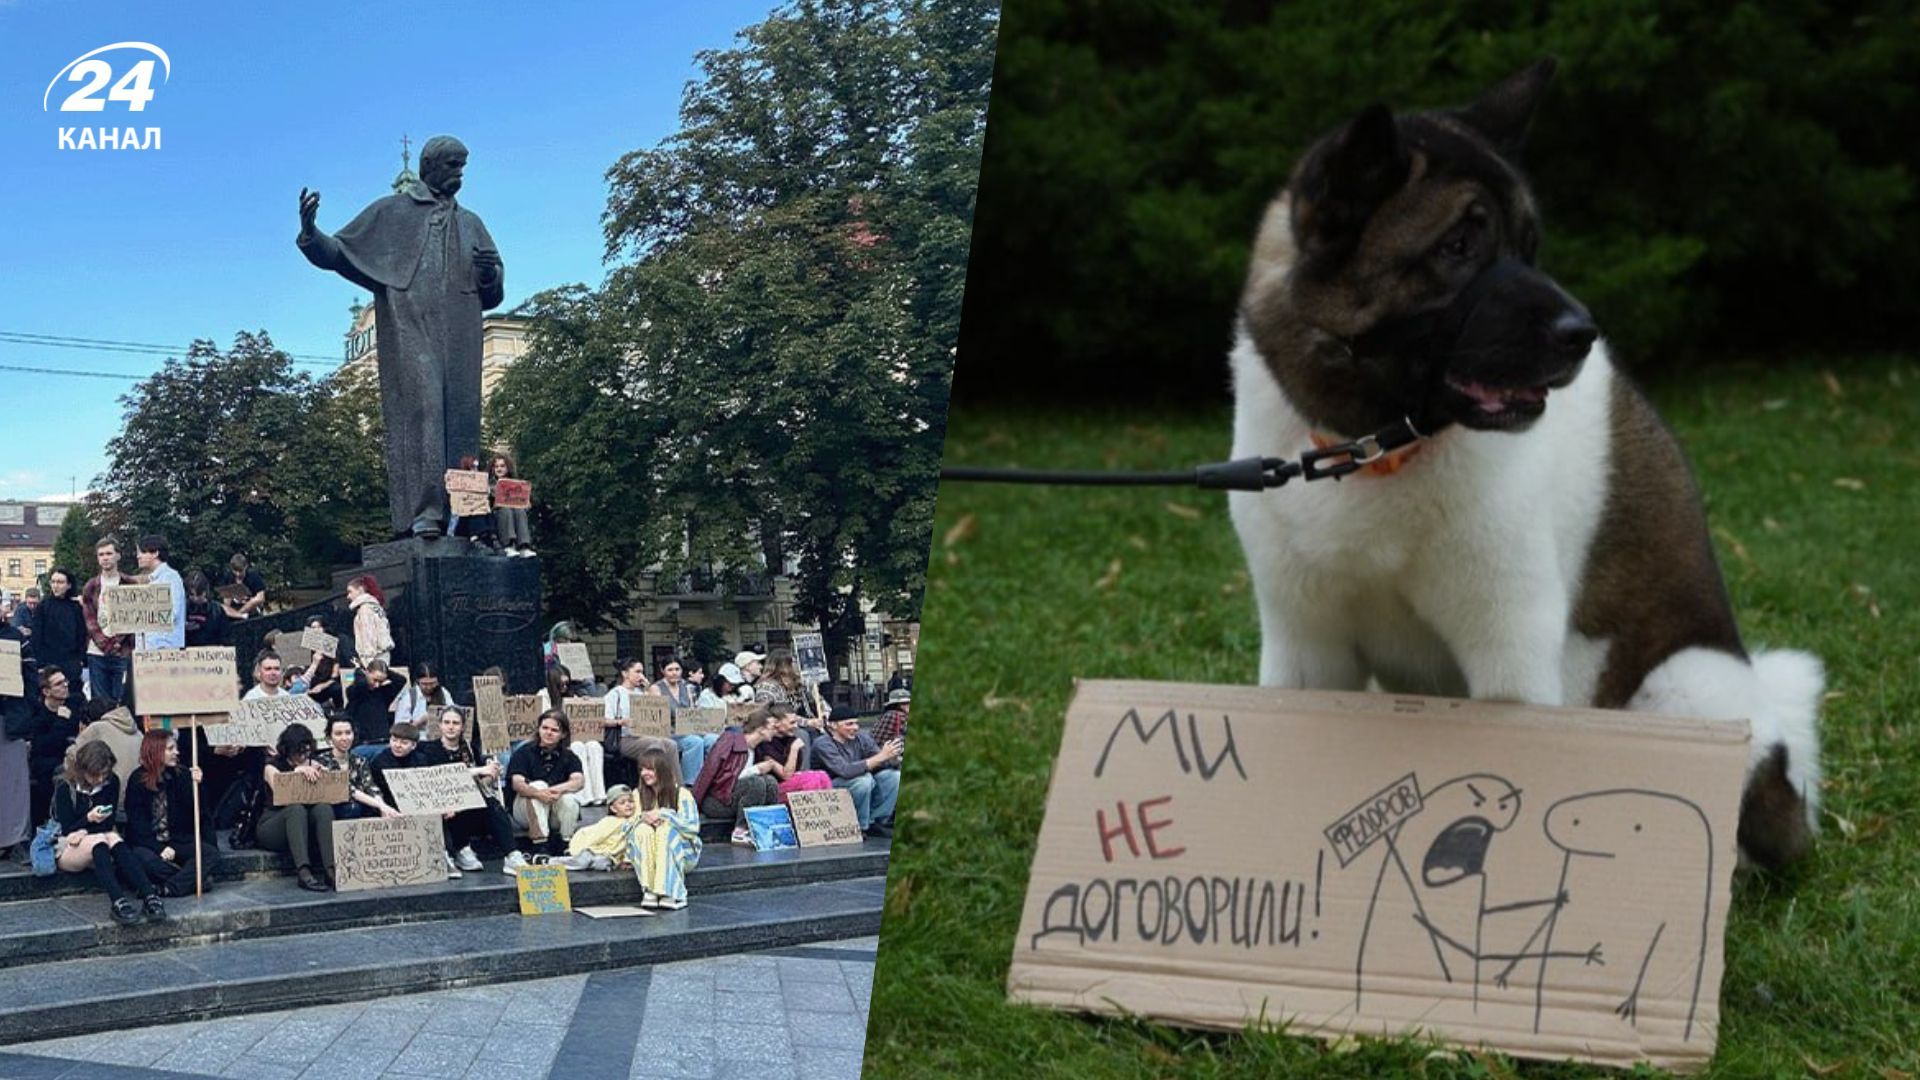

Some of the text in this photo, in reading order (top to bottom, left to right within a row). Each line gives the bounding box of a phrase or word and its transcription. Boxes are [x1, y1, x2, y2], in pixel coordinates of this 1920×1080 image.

[1094, 708, 1247, 781] МИ
[1096, 796, 1187, 863] НЕ
[1332, 784, 1418, 854] ФЕДОРОВ
[1031, 848, 1325, 951] ДОГОВОРИЛИ!
